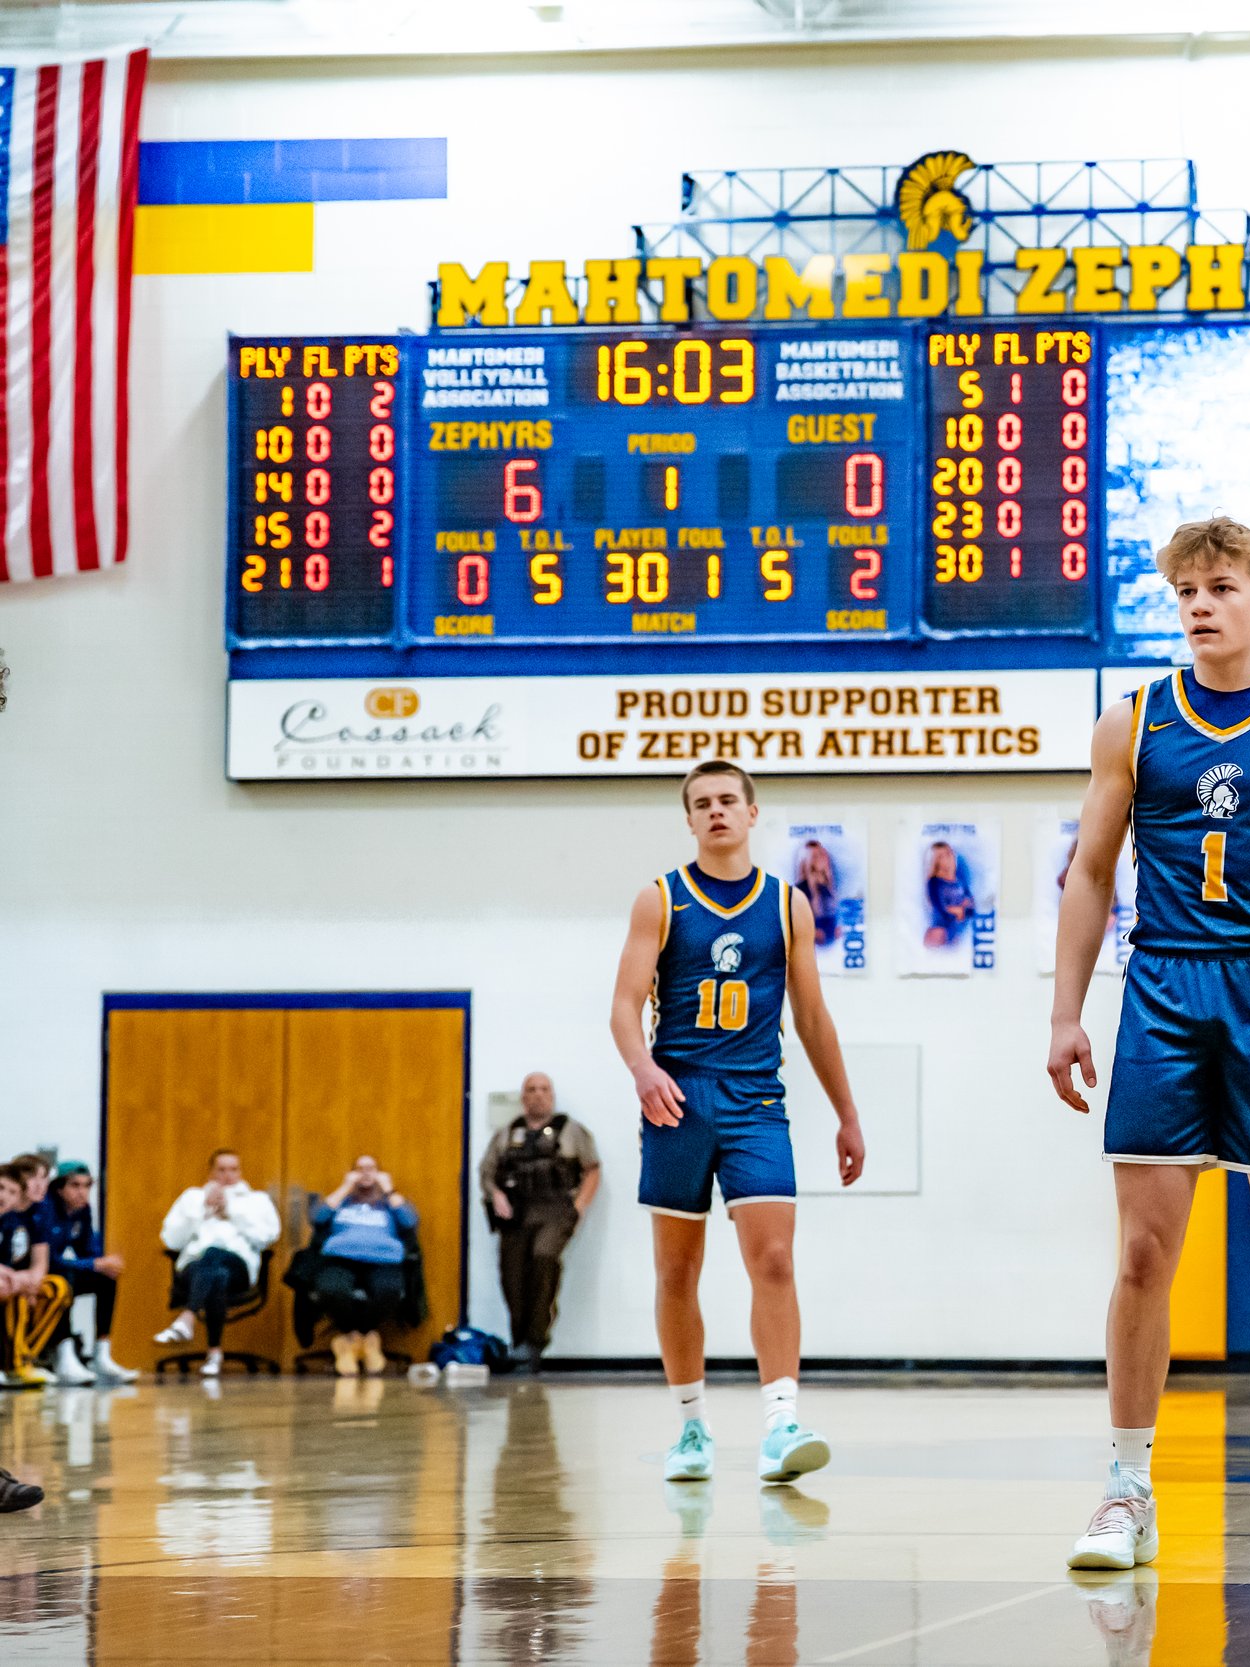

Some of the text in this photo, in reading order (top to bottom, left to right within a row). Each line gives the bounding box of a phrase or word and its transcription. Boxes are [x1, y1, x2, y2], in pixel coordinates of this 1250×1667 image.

[436, 250, 984, 327] MAHTOMEDI
[240, 345, 399, 378] PLY FL PTS
[428, 347, 545, 367] MAHTOMEDI
[929, 331, 1091, 366] PLY FL PTS
[423, 368, 549, 387] VOLLEYBALL
[597, 339, 755, 405] 16:03
[776, 361, 904, 380] BASKETBALL
[1011, 373, 1021, 404] 1
[1062, 368, 1087, 407] 0
[281, 381, 395, 420] 1 0 2
[422, 389, 549, 408] ASSOCIATION
[776, 382, 904, 401] ASSOCIATION
[255, 424, 395, 463] 10 0 0
[429, 421, 554, 451] ZEPHYRS
[787, 413, 877, 444] GUEST
[945, 412, 1087, 452] 10 0 0
[255, 467, 395, 505] 14 0 0
[504, 458, 542, 523] 6
[665, 465, 678, 511] 1
[845, 453, 883, 517] 0
[932, 455, 1087, 496] 20 0 0
[255, 510, 394, 549] 15 0 2
[828, 525, 889, 546] FOULS
[932, 498, 1087, 539] 23 0 0
[435, 530, 496, 552] FOULS
[594, 527, 726, 550] PLAYER FOUL
[241, 554, 394, 592] 21 0 1
[457, 554, 563, 605] 0 5
[606, 552, 720, 604] 30 1
[760, 549, 881, 602] 5 2
[935, 542, 1087, 582] 30 1 0
[632, 612, 697, 633] MATCH
[616, 686, 1001, 719] PROUD SUPPORTER
[274, 699, 501, 751] Cossack
[577, 727, 1040, 760] OF ZEPHYR ATHLETICS
[276, 754, 502, 770] FOUNDATION
[1201, 831, 1228, 902] 1
[695, 978, 749, 1031] 10
